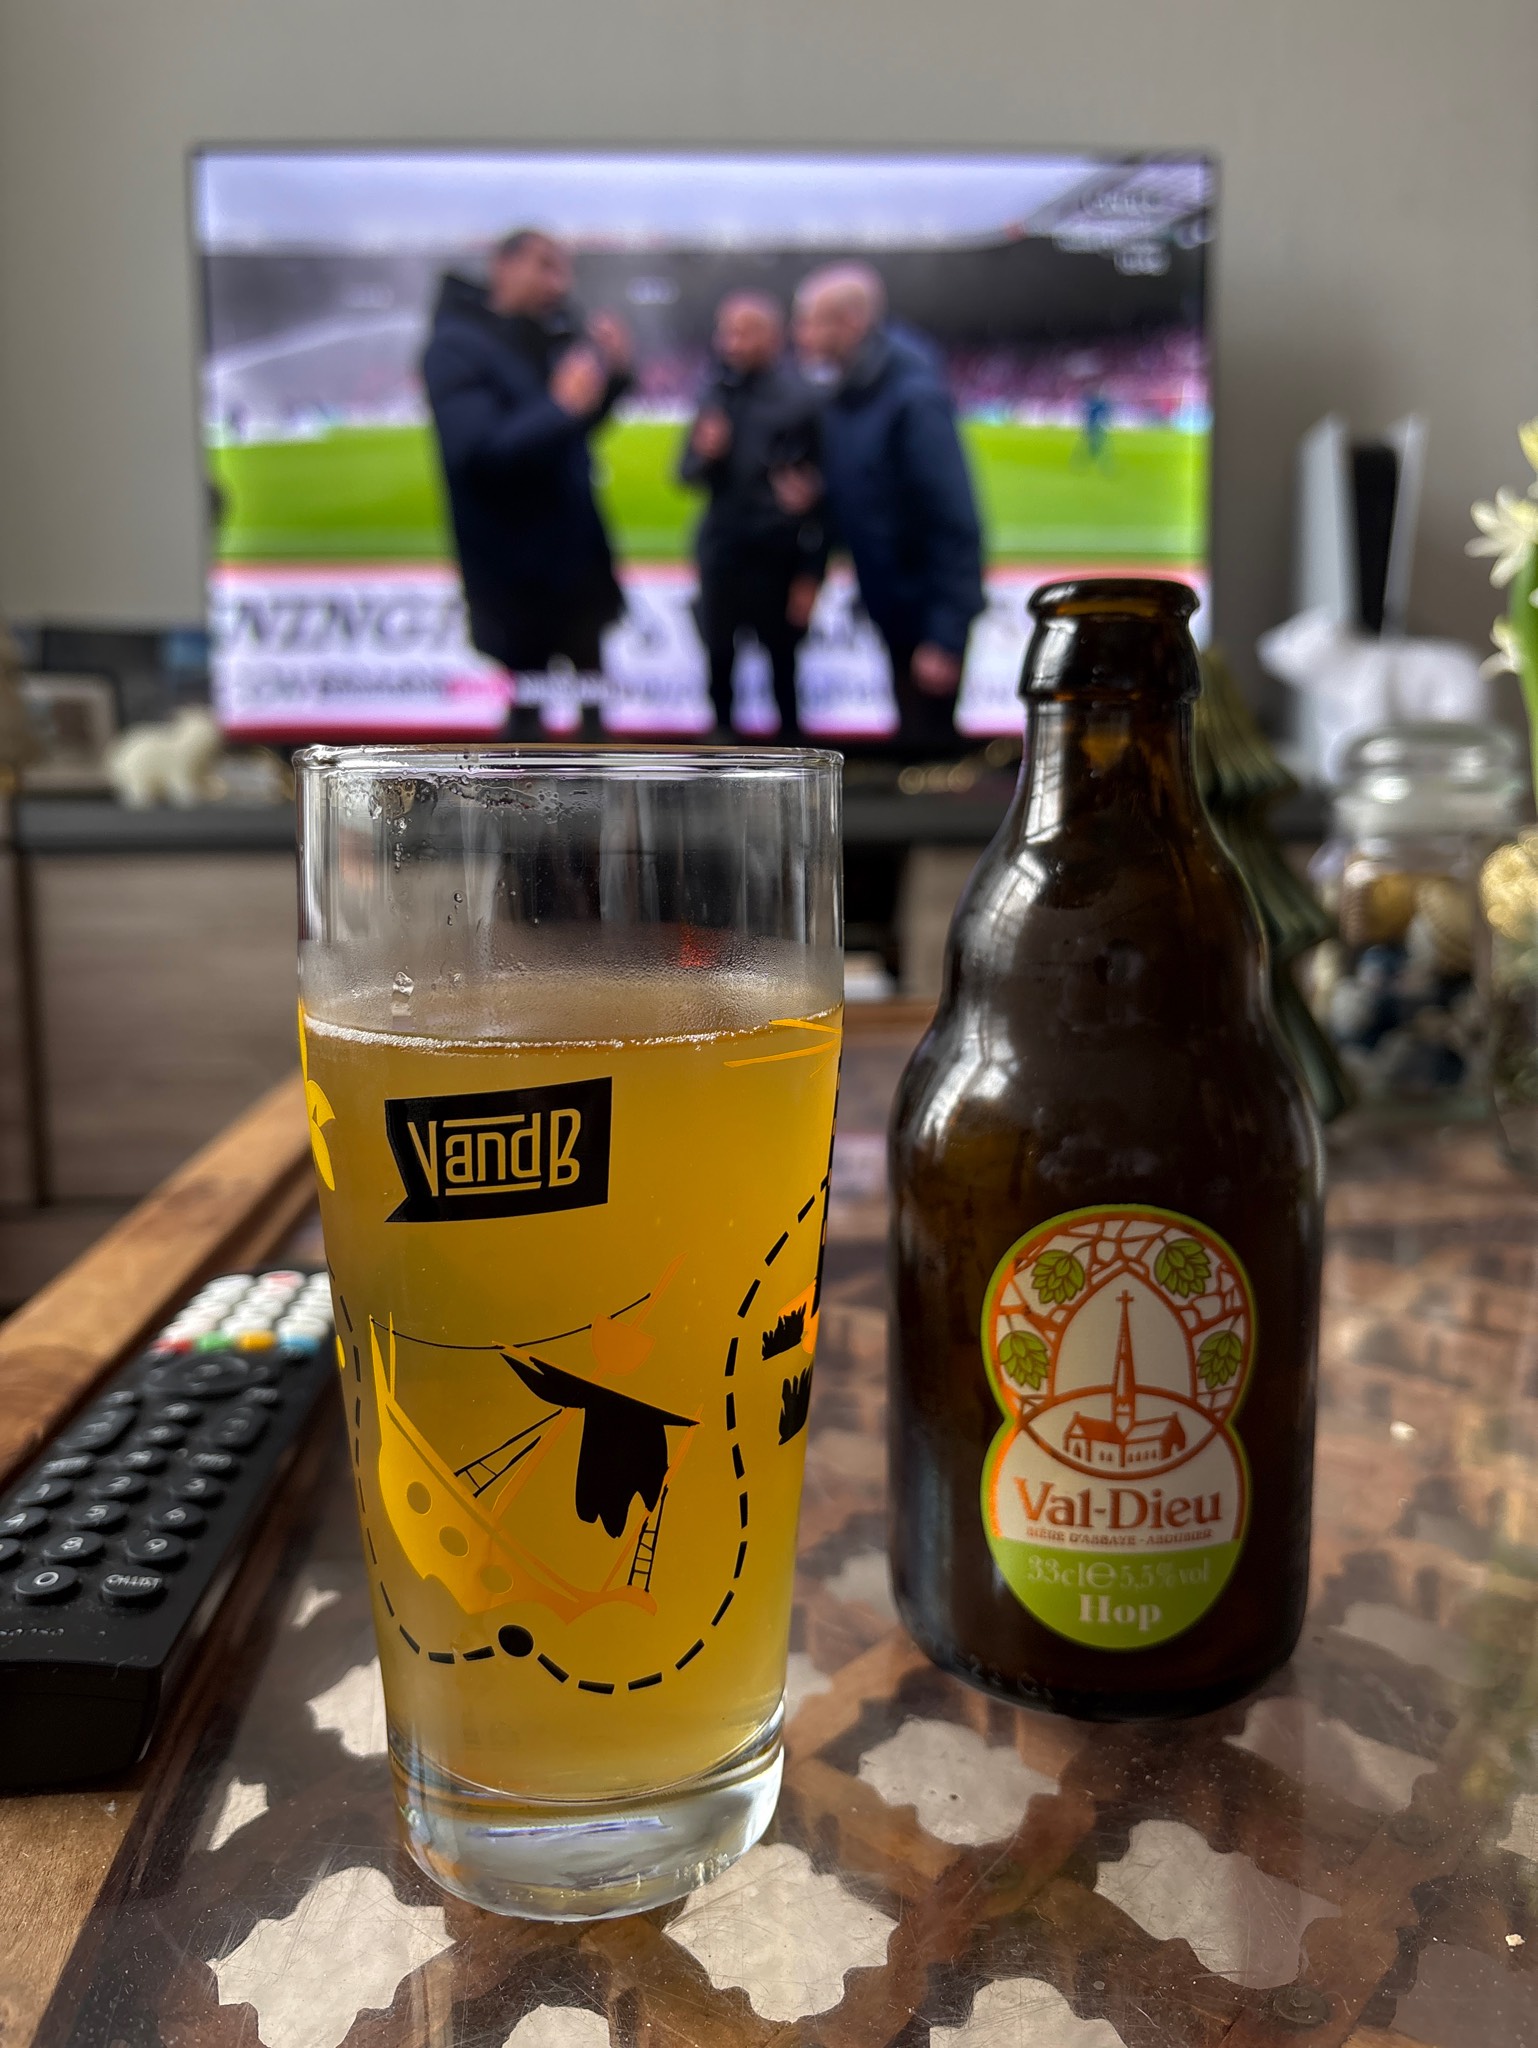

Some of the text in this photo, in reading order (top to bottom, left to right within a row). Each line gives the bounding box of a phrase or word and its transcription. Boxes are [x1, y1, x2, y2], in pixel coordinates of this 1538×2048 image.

[106, 1476, 132, 1491] 2
[1013, 1477, 1223, 1530] Val-Dieu
[33, 1571, 60, 1587] 0
[1178, 1557, 1211, 1585] vol
[1079, 1593, 1163, 1632] Hop
